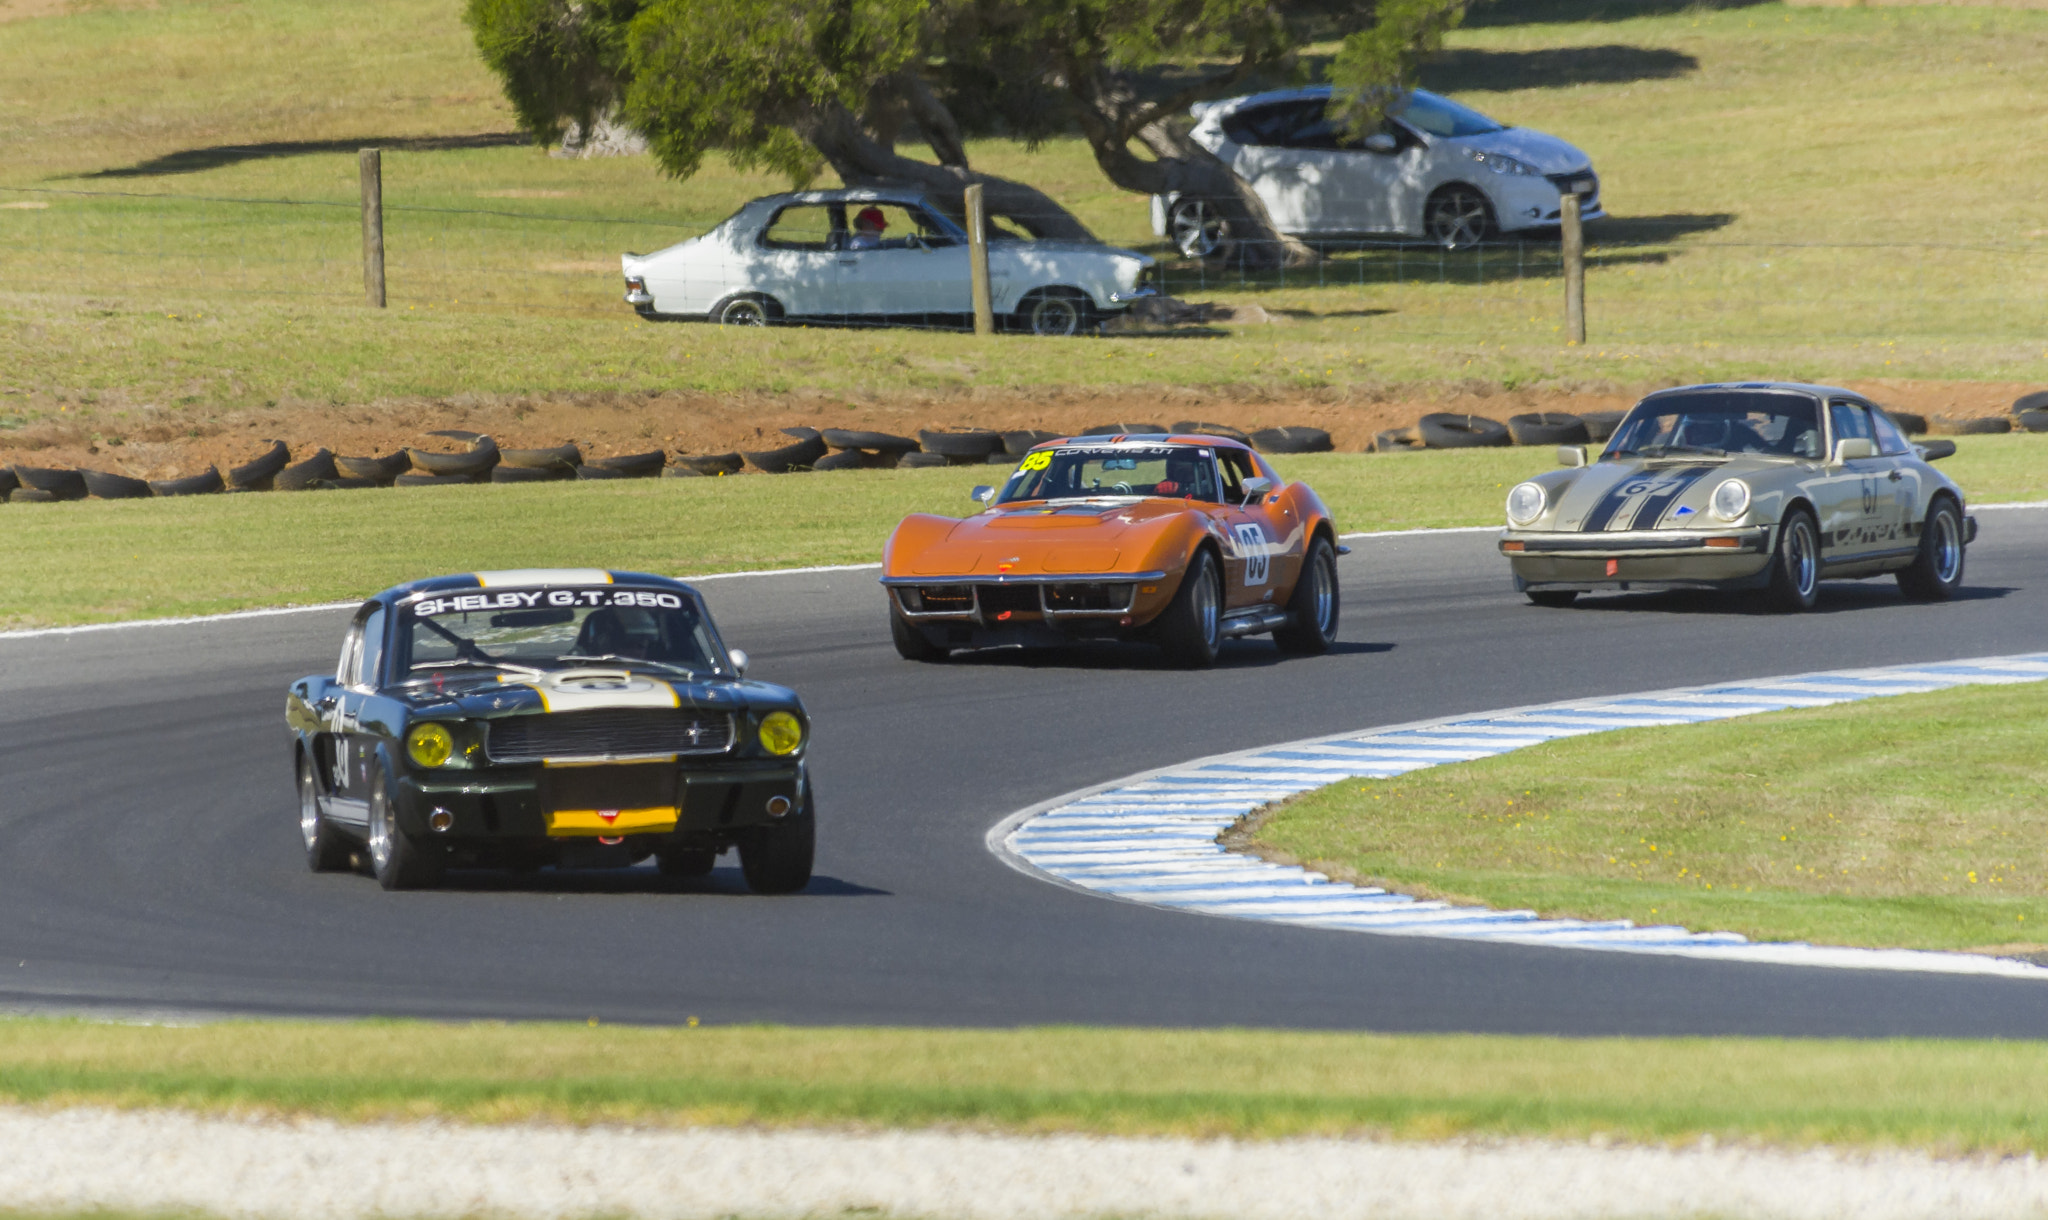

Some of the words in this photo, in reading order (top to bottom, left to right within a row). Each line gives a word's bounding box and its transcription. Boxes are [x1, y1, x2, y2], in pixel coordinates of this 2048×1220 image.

[1019, 450, 1054, 472] 85
[1625, 481, 1678, 495] 67
[414, 591, 543, 617] SHELBY
[547, 590, 682, 609] G.T.350
